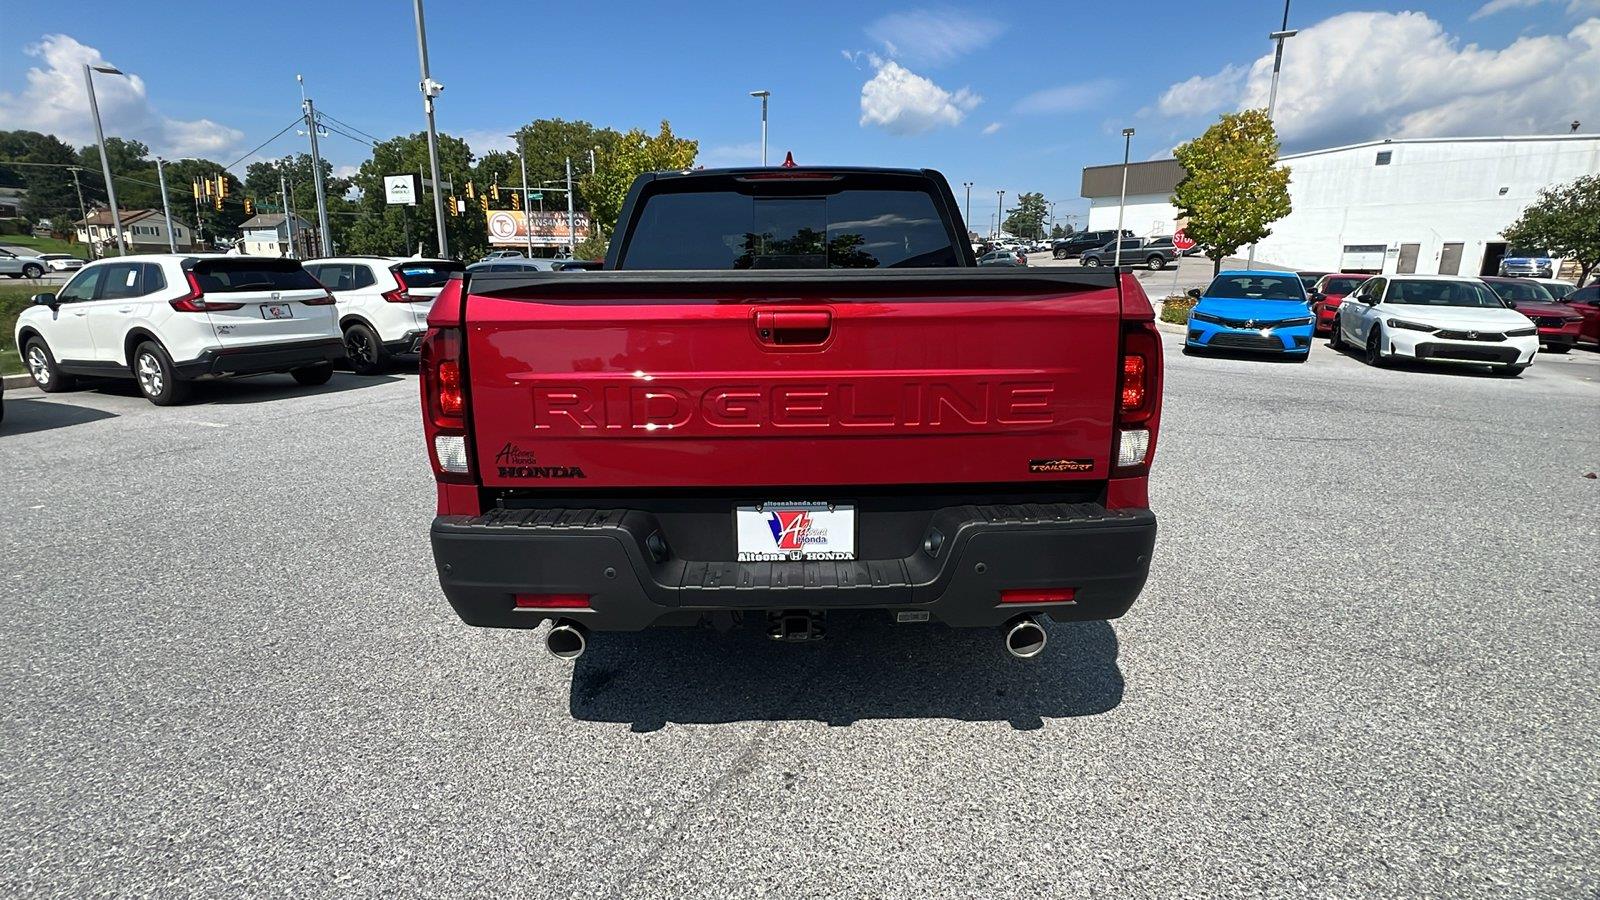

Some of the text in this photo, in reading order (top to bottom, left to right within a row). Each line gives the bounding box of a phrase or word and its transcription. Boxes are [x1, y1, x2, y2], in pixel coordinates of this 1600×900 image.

[519, 219, 589, 227] TRANS4MATON
[531, 381, 1055, 429] RIDGELINE
[497, 466, 586, 478] HONDA
[797, 536, 827, 544] Honda
[737, 552, 855, 562] Altoona HONDA
